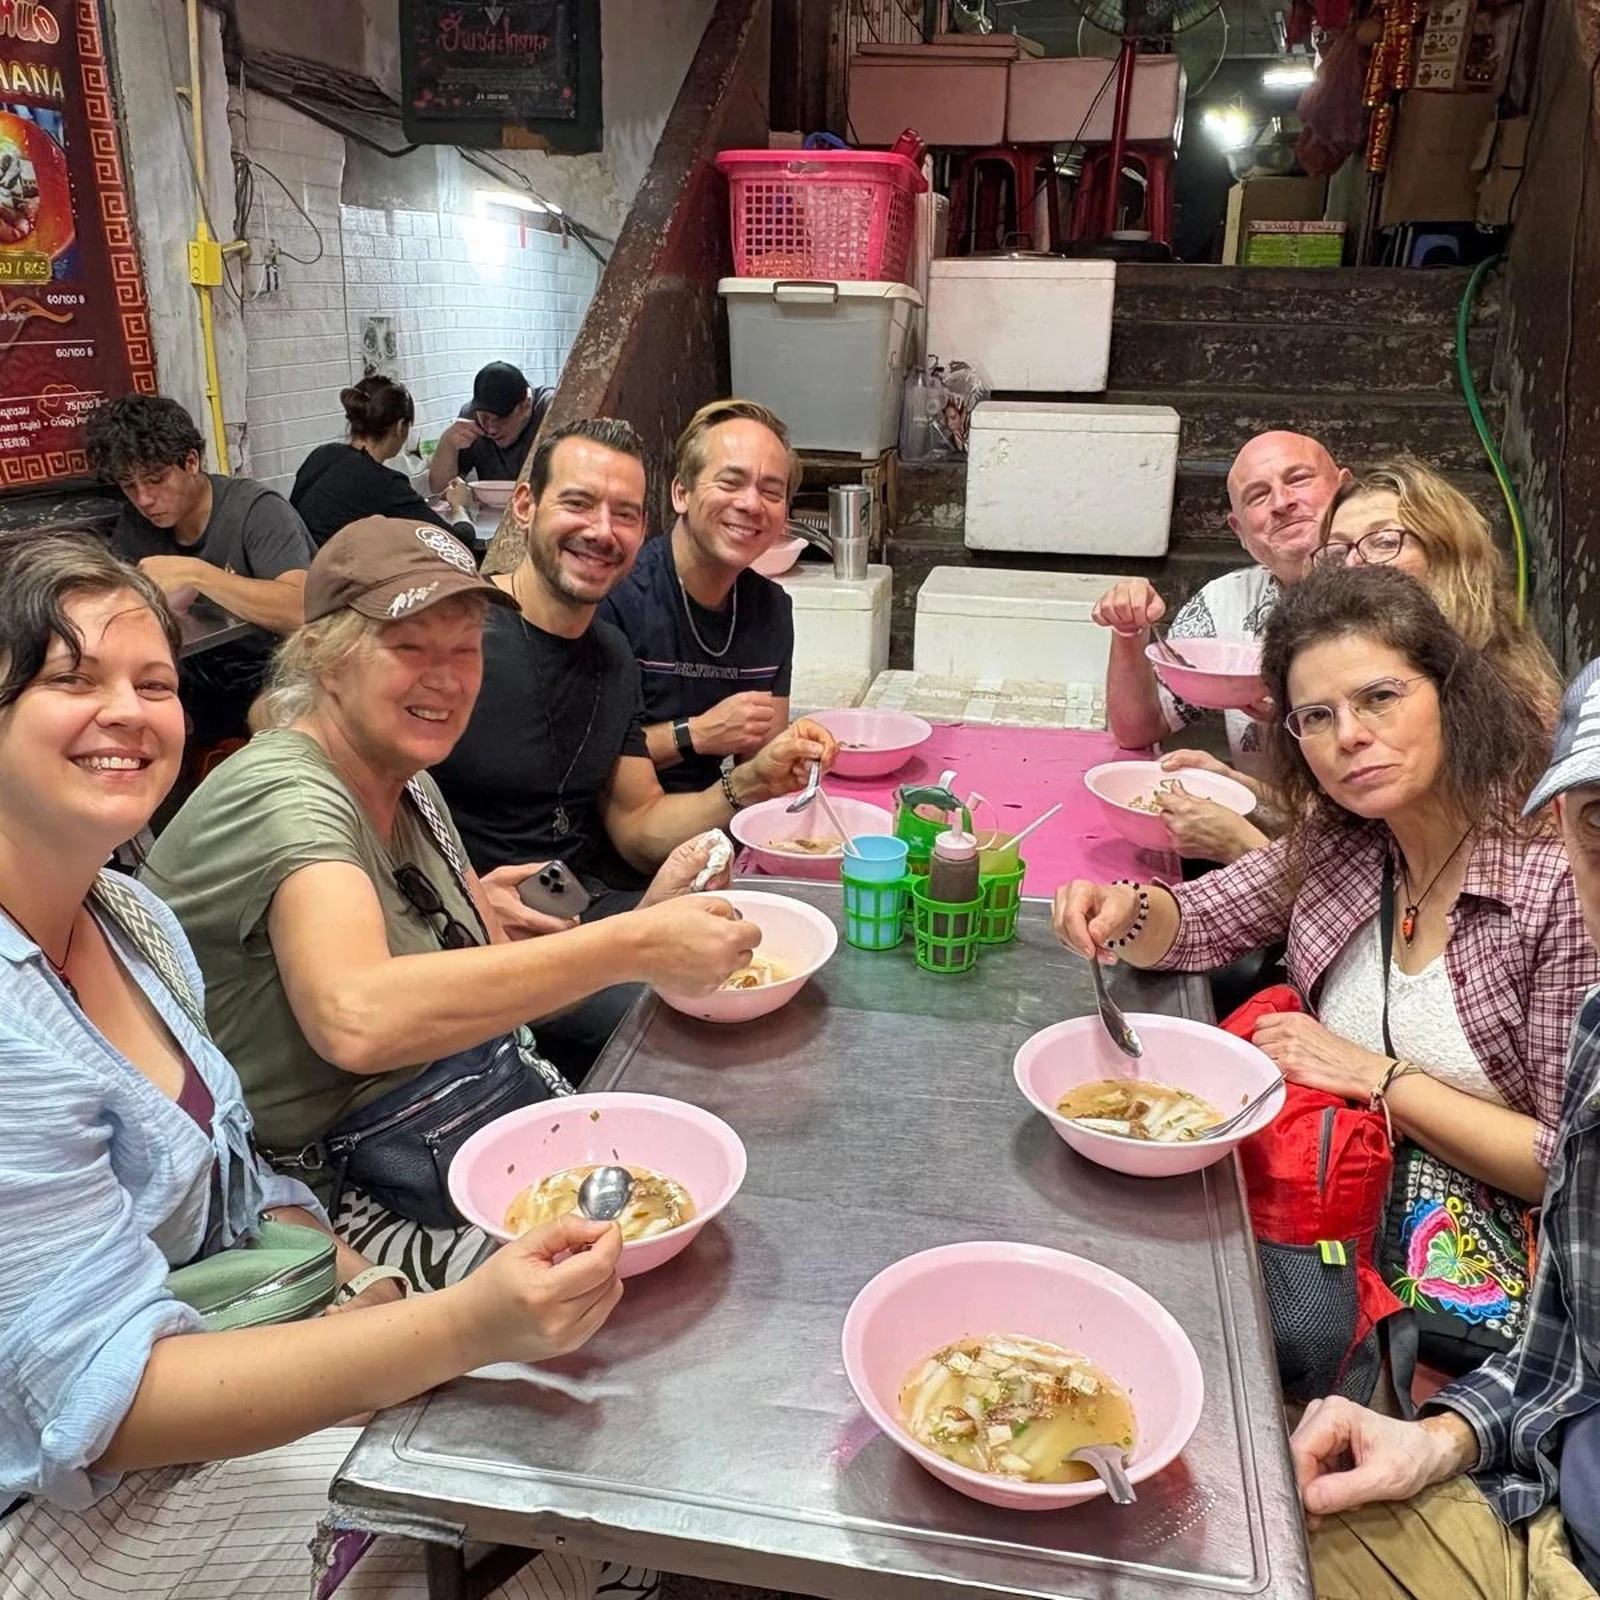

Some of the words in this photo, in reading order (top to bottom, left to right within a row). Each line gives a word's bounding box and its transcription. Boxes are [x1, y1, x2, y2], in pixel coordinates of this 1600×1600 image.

[24, 261, 45, 275] RICE
[47, 294, 77, 304] 60/100
[56, 348, 85, 358] 60/100
